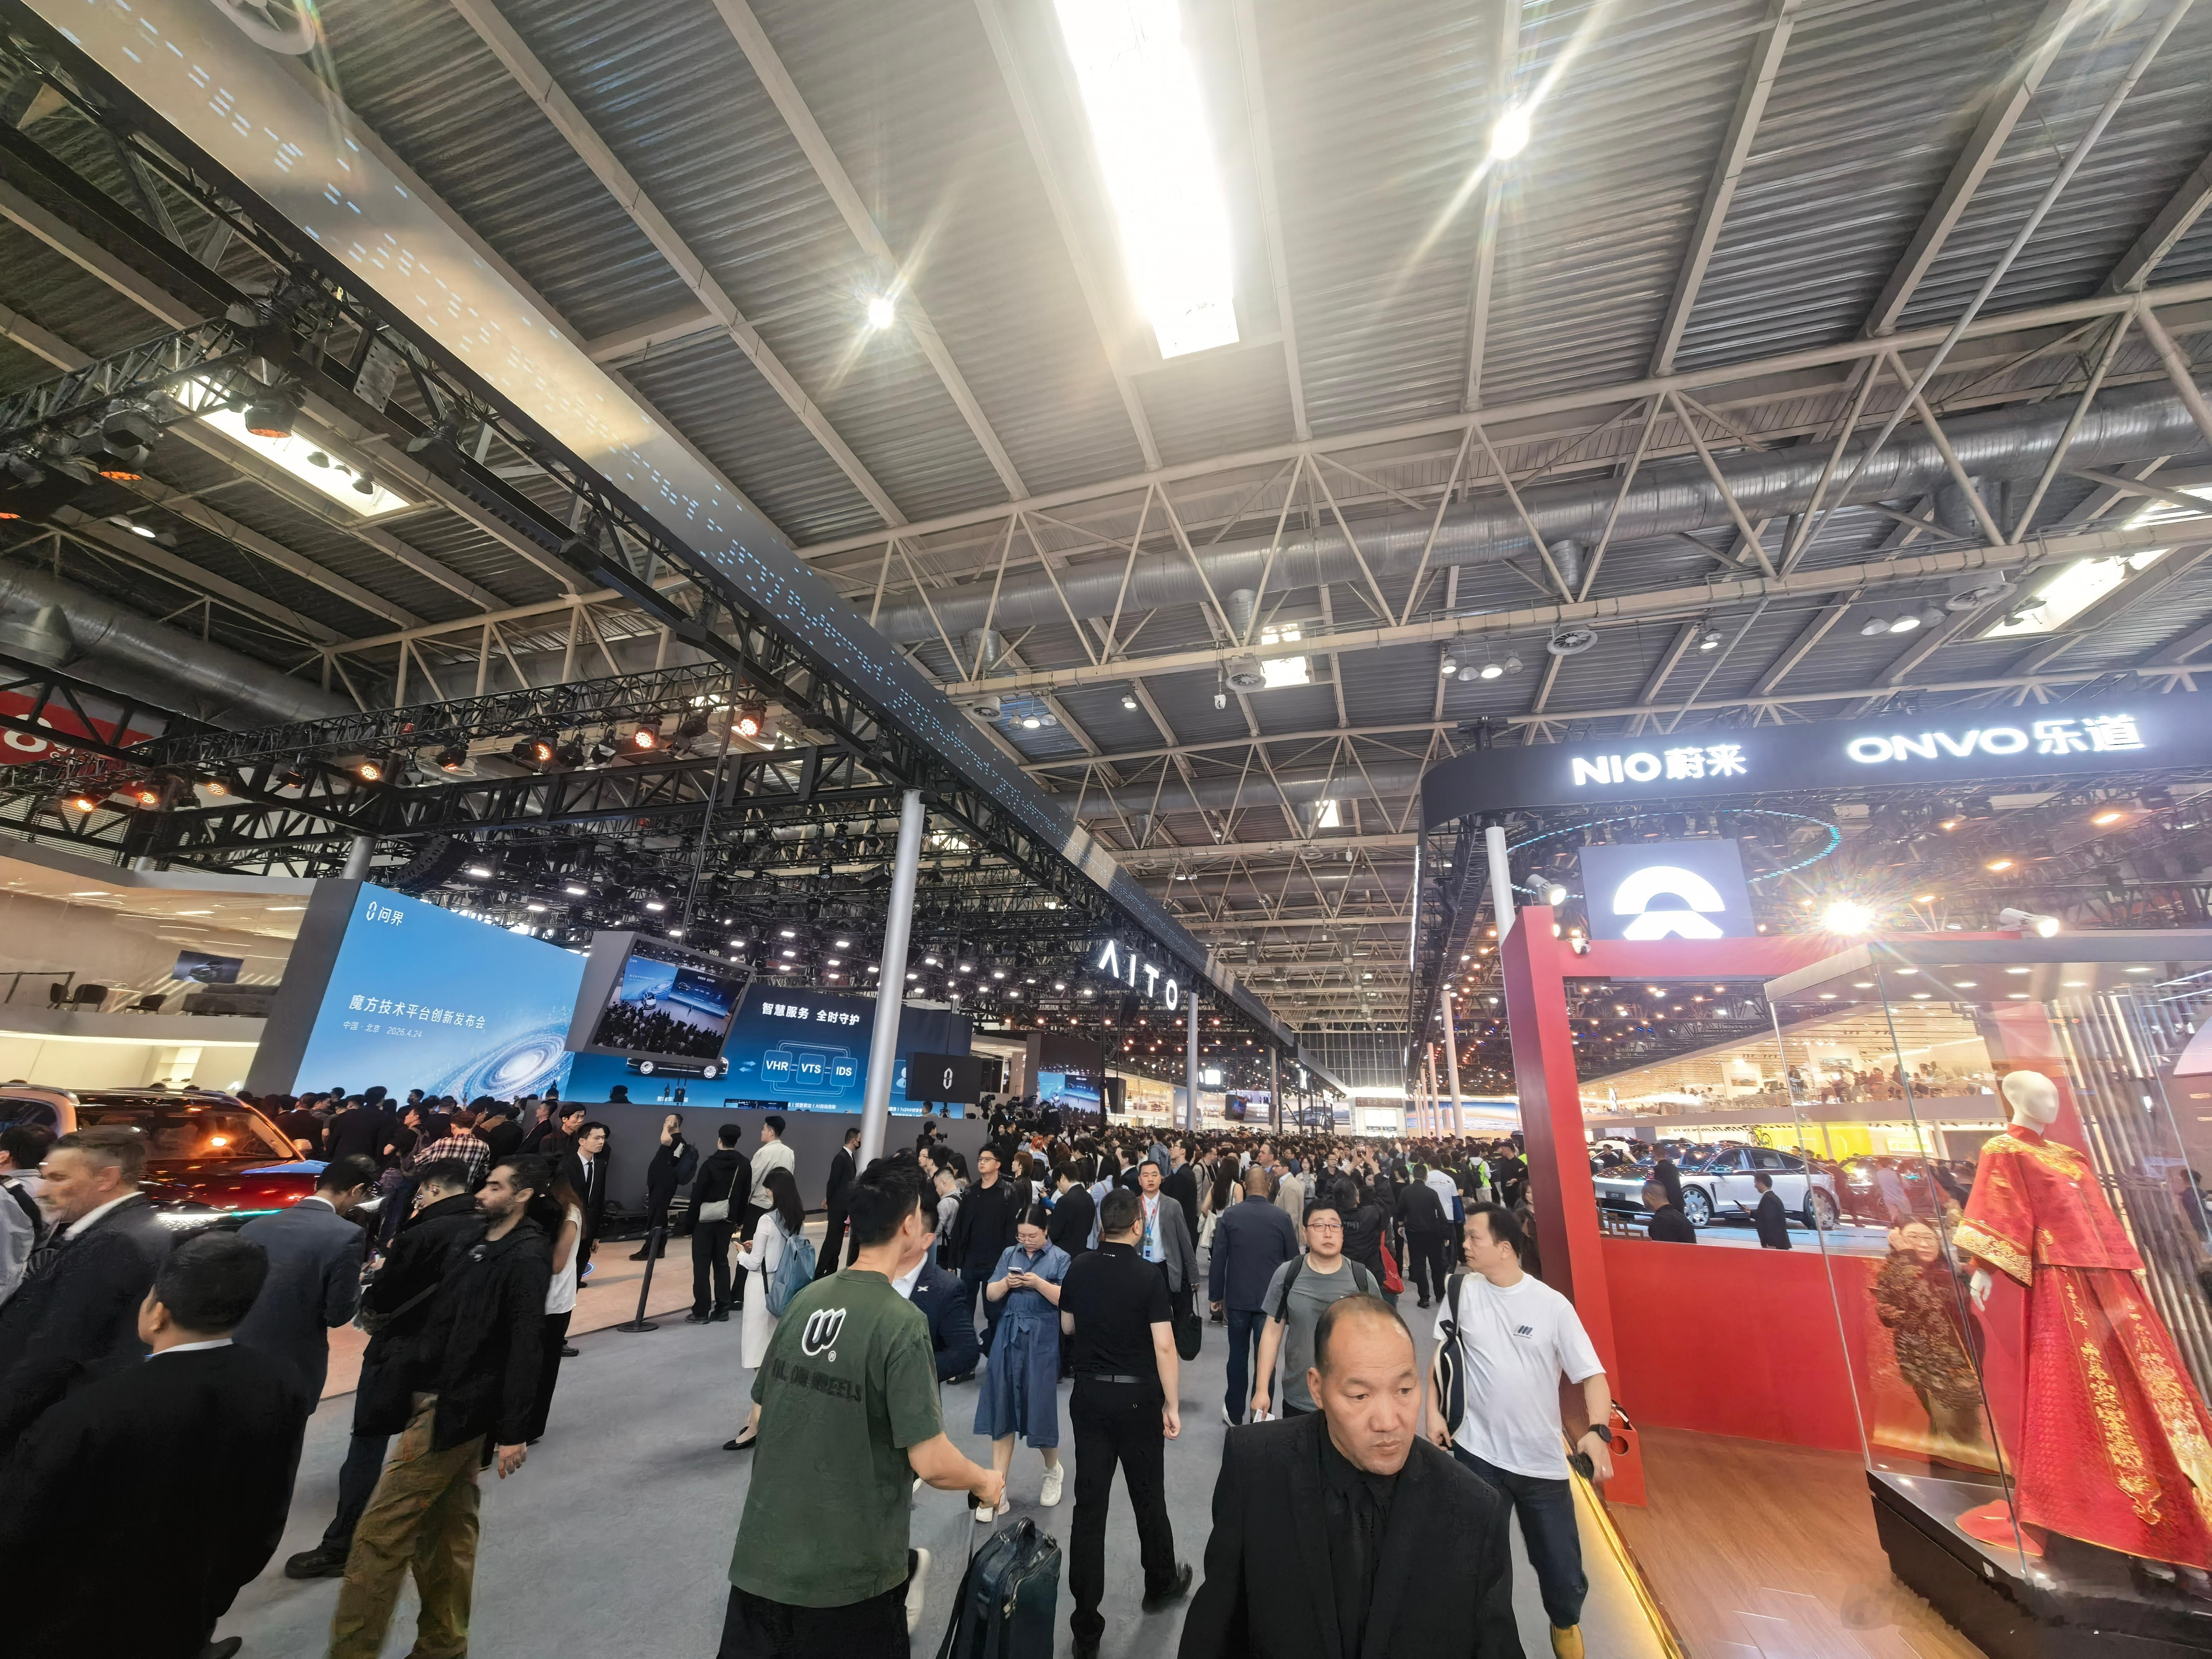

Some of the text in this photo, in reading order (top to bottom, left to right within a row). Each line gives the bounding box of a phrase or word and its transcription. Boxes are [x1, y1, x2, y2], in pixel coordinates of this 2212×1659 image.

[1848, 714, 2146, 763] ONVO 乐道
[1572, 744, 1747, 786] NIO 蔚来
[378, 906, 404, 926] 问界
[349, 994, 486, 1029] 魔方技术平台创新发布会
[762, 1002, 860, 1026] 智慧服务 全时守护
[387, 1027, 422, 1038] 2026.4.24
[766, 1060, 788, 1071] VHR
[801, 1063, 821, 1074] VTS
[836, 1066, 852, 1077] IDS
